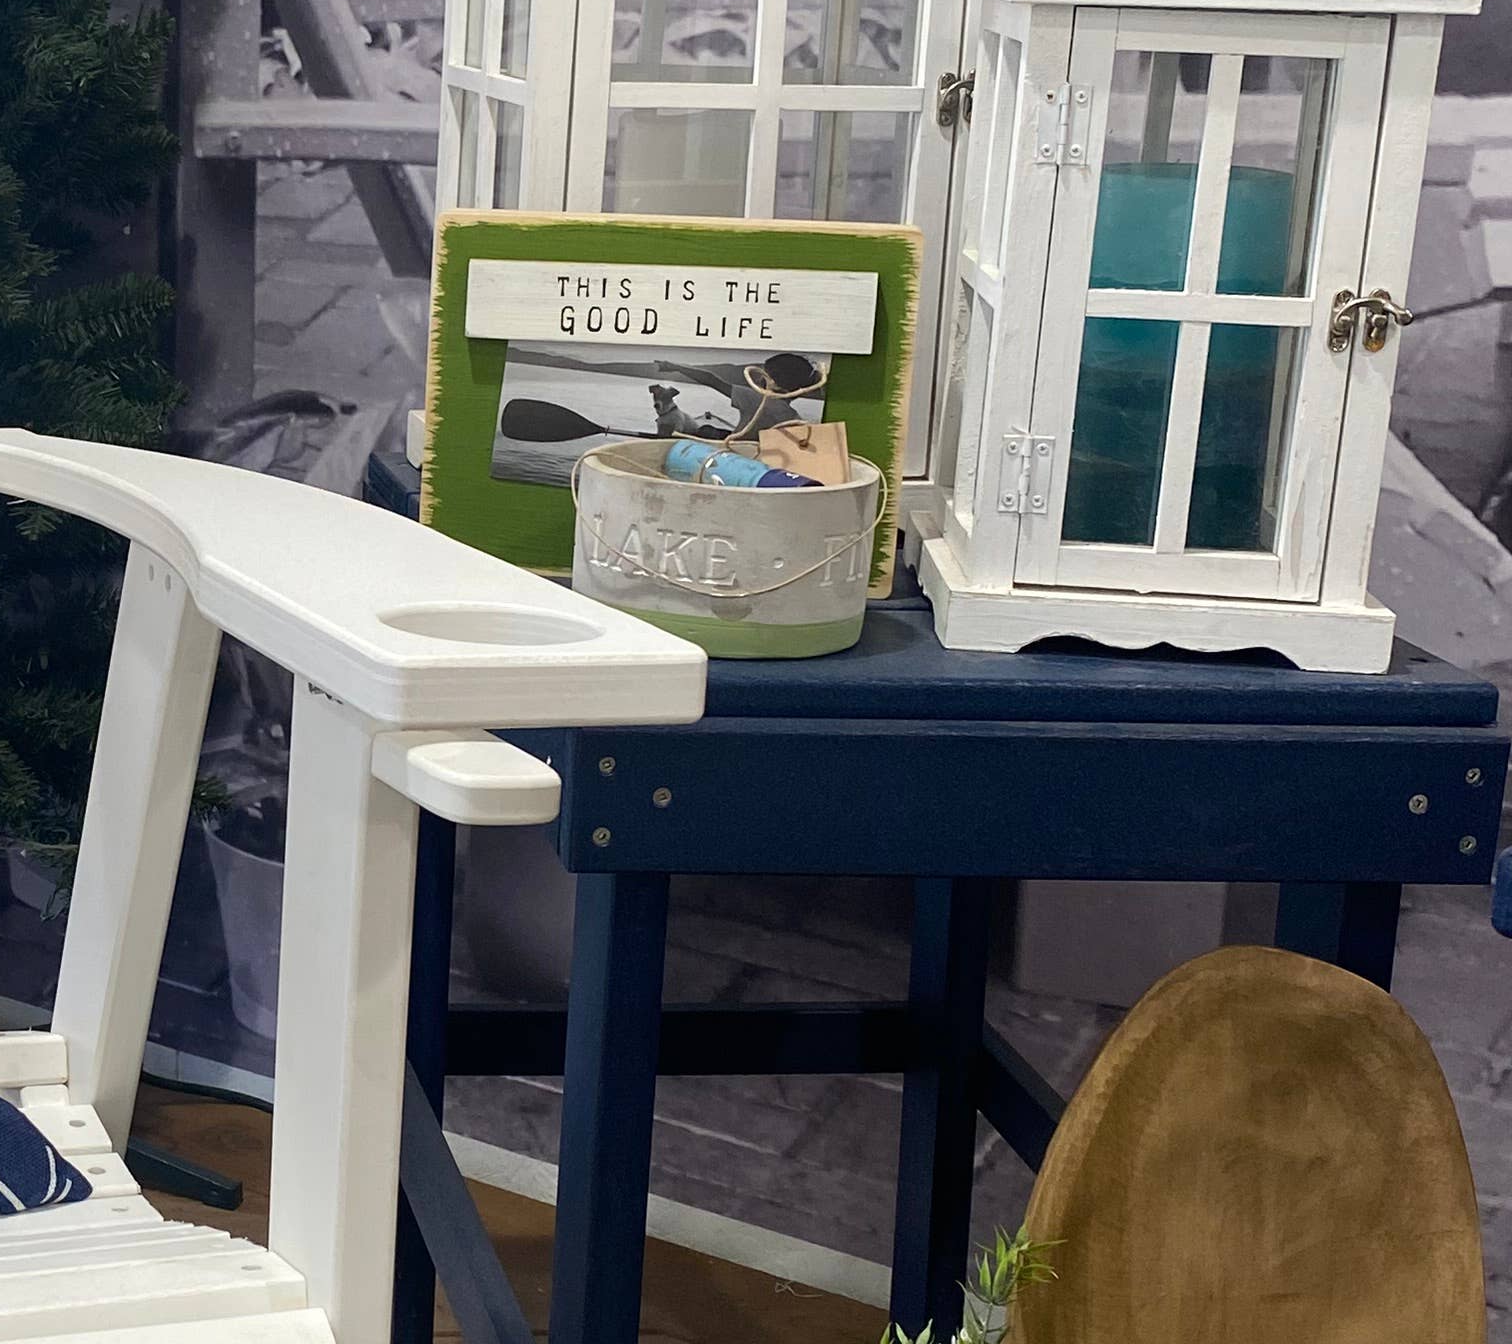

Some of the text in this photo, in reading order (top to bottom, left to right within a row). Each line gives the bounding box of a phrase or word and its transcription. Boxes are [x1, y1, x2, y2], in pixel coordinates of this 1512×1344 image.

[557, 276, 781, 304] THIS IS THE
[560, 305, 774, 339] GOOD LIFE
[588, 513, 737, 587] LAKE
